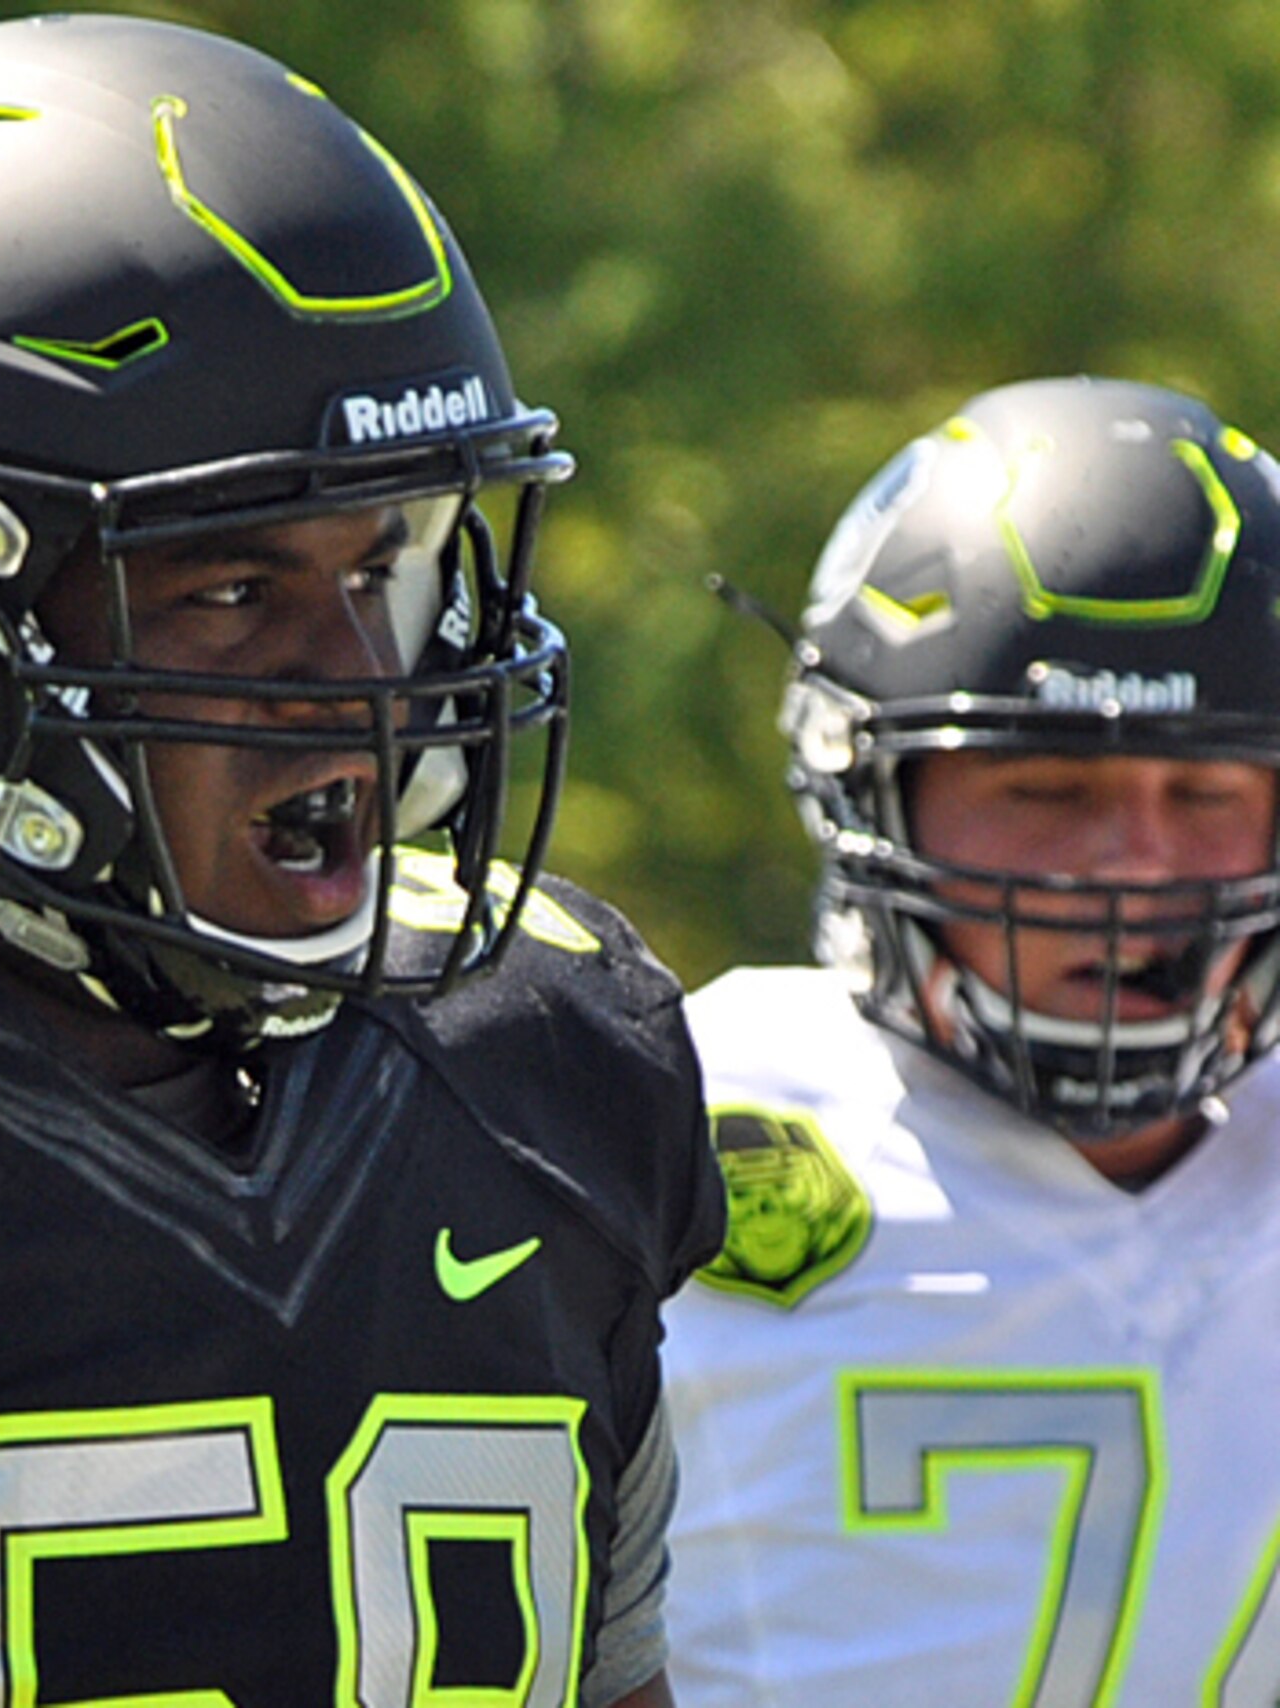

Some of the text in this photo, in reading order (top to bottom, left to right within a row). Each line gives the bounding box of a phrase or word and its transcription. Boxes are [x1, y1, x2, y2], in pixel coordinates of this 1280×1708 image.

[342, 376, 487, 443] Riddell
[1037, 668, 1196, 713] Riddell
[837, 1368, 1280, 1708] 7
